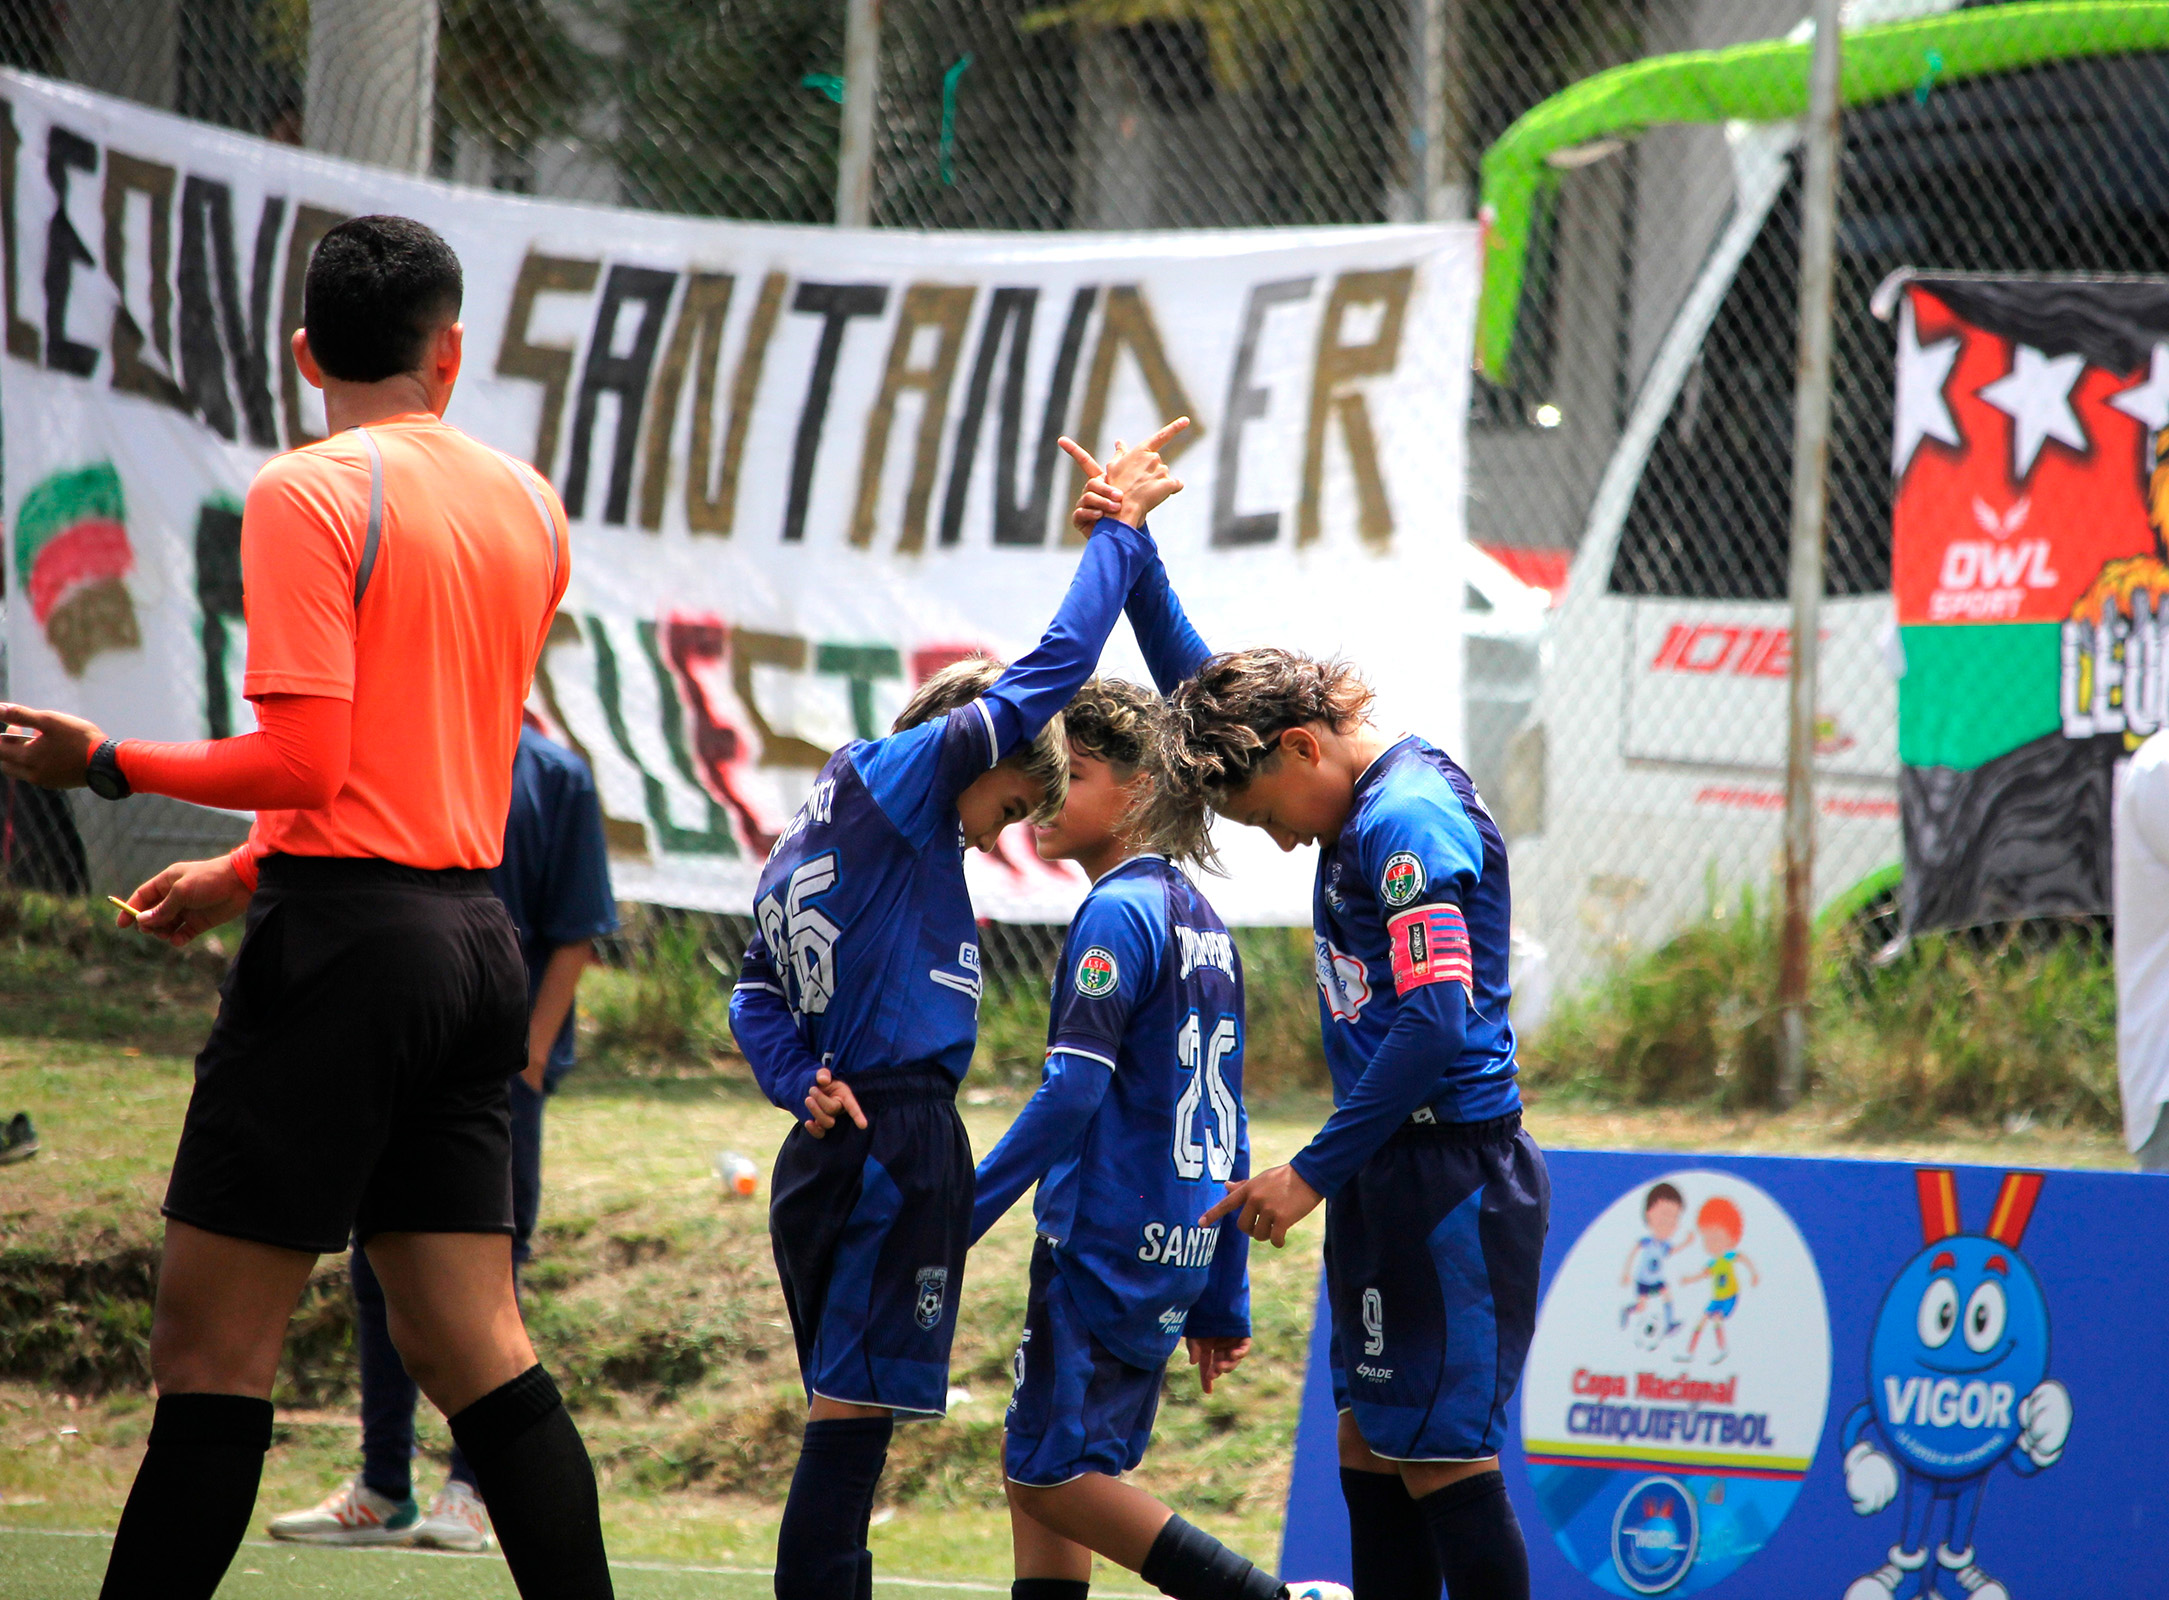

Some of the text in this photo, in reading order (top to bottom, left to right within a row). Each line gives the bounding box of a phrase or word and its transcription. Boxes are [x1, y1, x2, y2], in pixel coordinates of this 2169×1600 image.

[494, 244, 1418, 558] SANTANDER
[1939, 540, 2059, 589] OWL
[1928, 588, 2027, 620] SPORT
[1088, 959, 1105, 970] LSF
[1173, 1013, 1238, 1181] 25
[1362, 1287, 1384, 1356] 9
[1572, 1368, 1737, 1405] Copa Nacional
[1884, 1375, 2015, 1429] VIGOR
